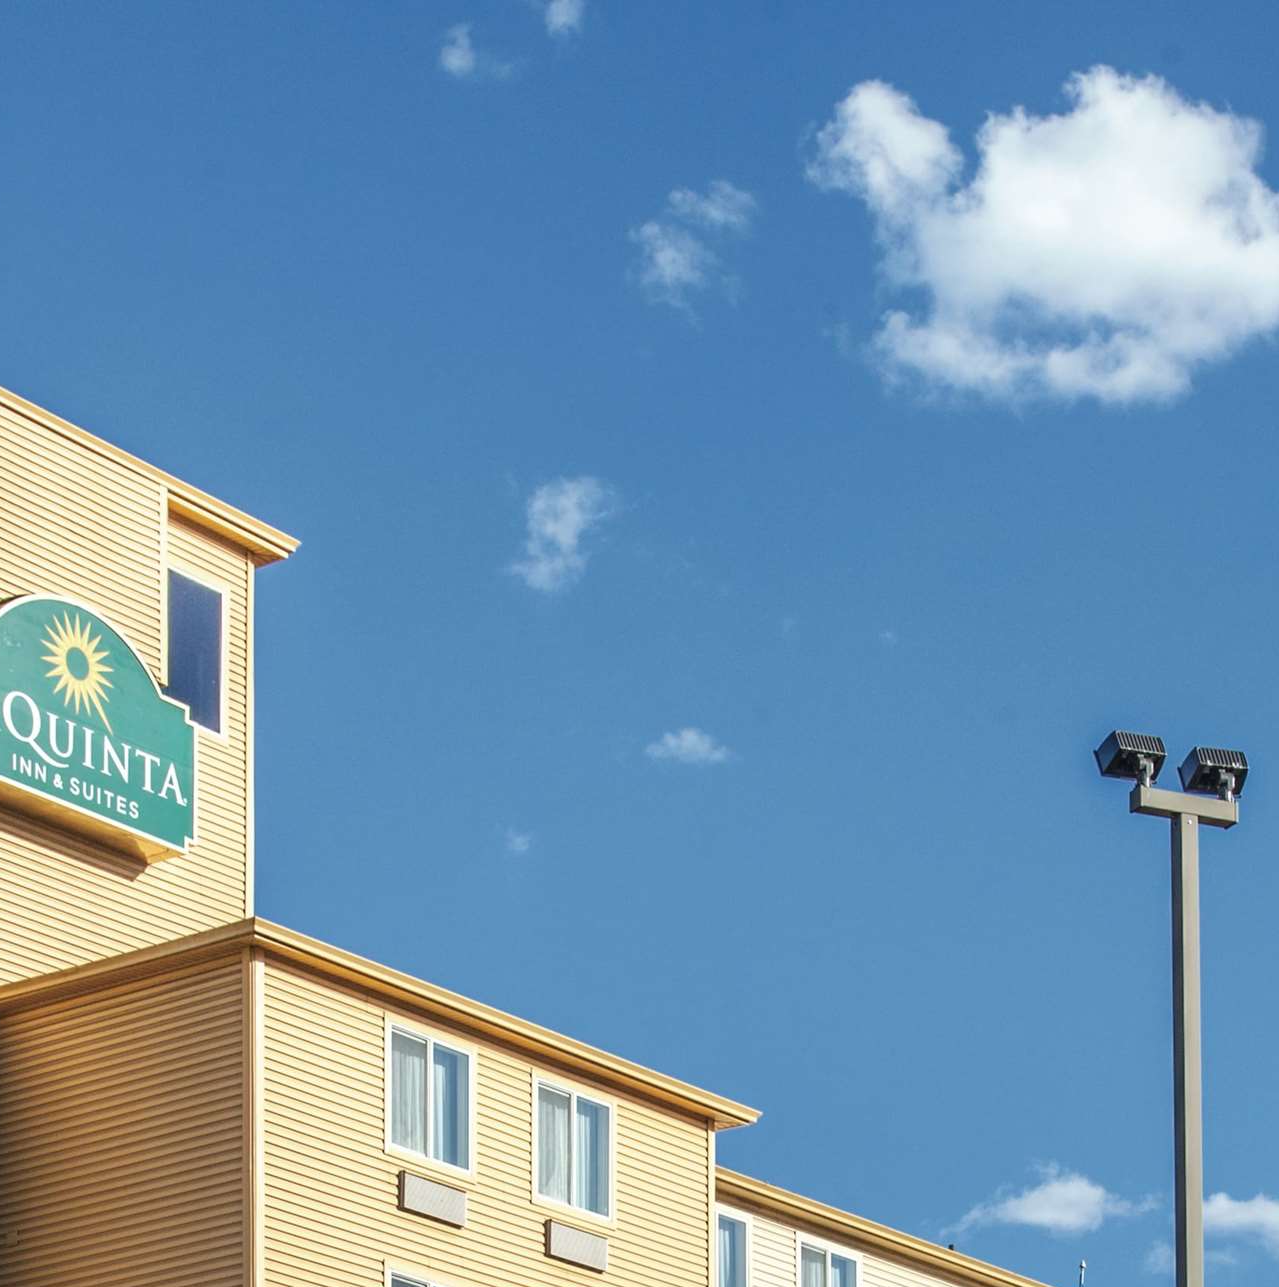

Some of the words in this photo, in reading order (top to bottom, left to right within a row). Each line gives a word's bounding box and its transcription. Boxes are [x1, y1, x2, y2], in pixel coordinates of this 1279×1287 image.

[12, 752, 47, 784] INN
[52, 773, 64, 790] &
[69, 776, 140, 820] SUITES
